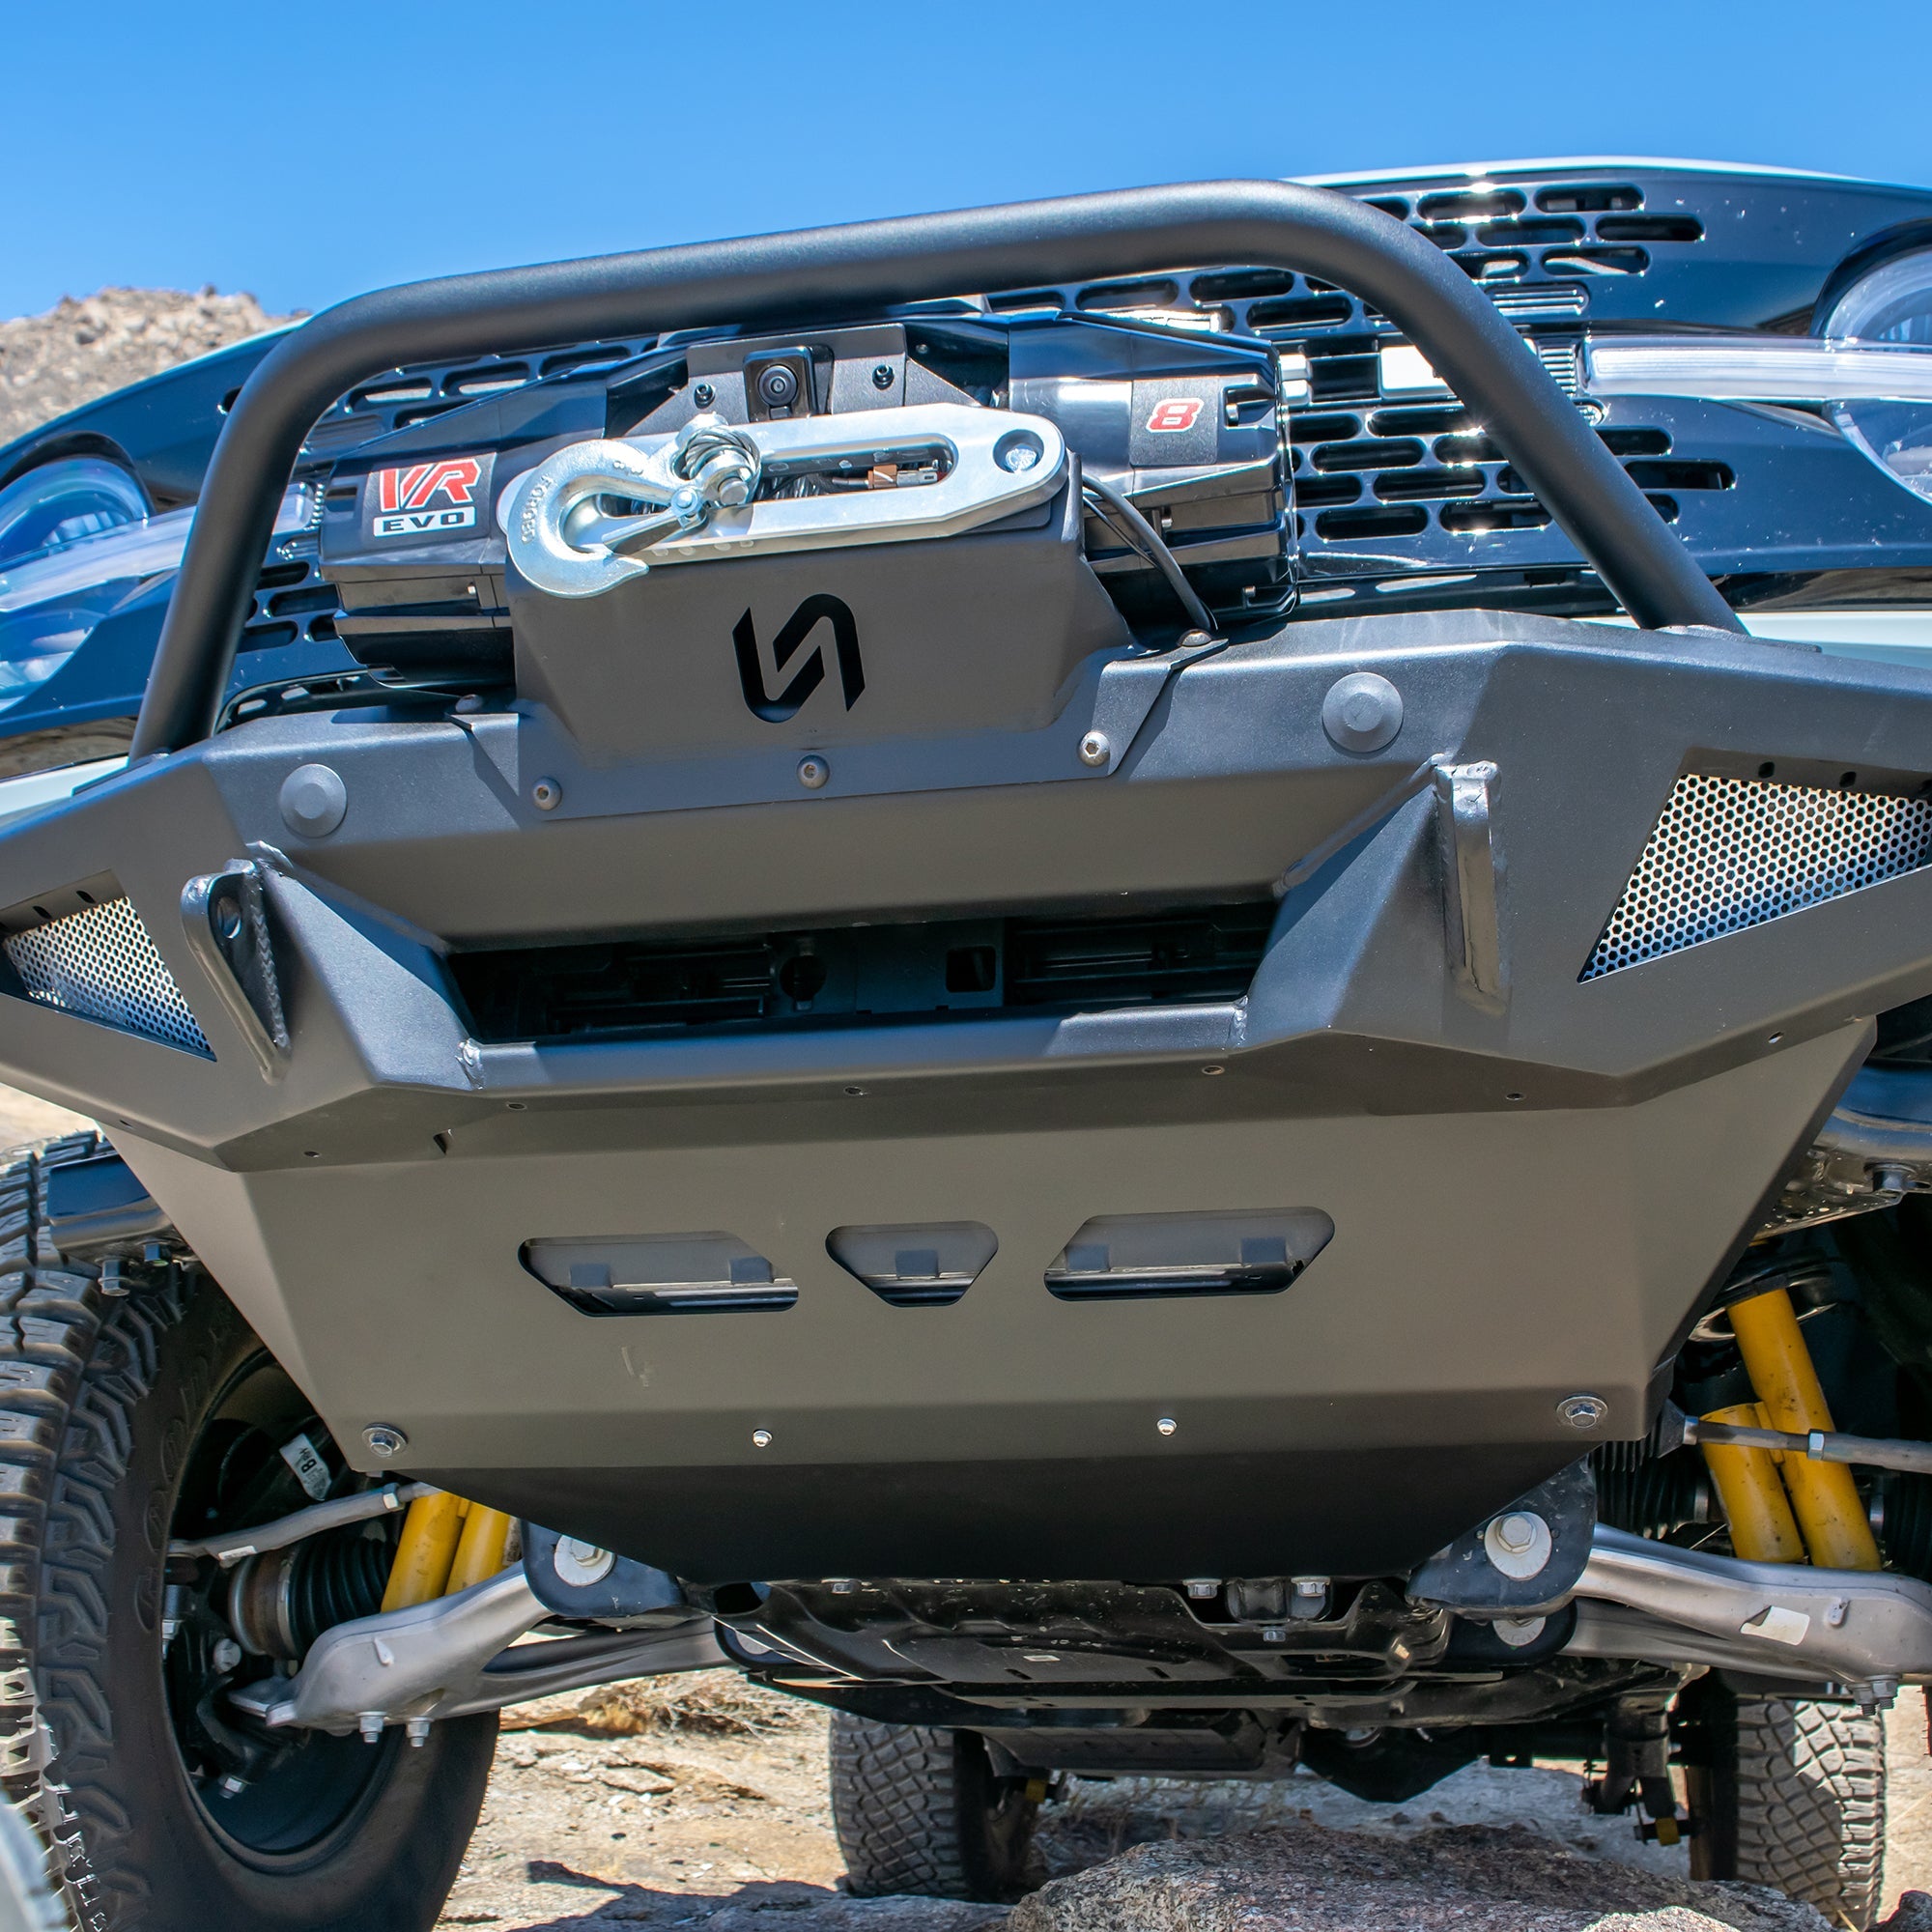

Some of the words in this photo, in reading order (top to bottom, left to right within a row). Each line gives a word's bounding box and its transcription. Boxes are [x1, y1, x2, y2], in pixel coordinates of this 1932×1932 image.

[1146, 397, 1205, 434] 8
[380, 458, 482, 513] VR
[383, 511, 465, 532] EVO
